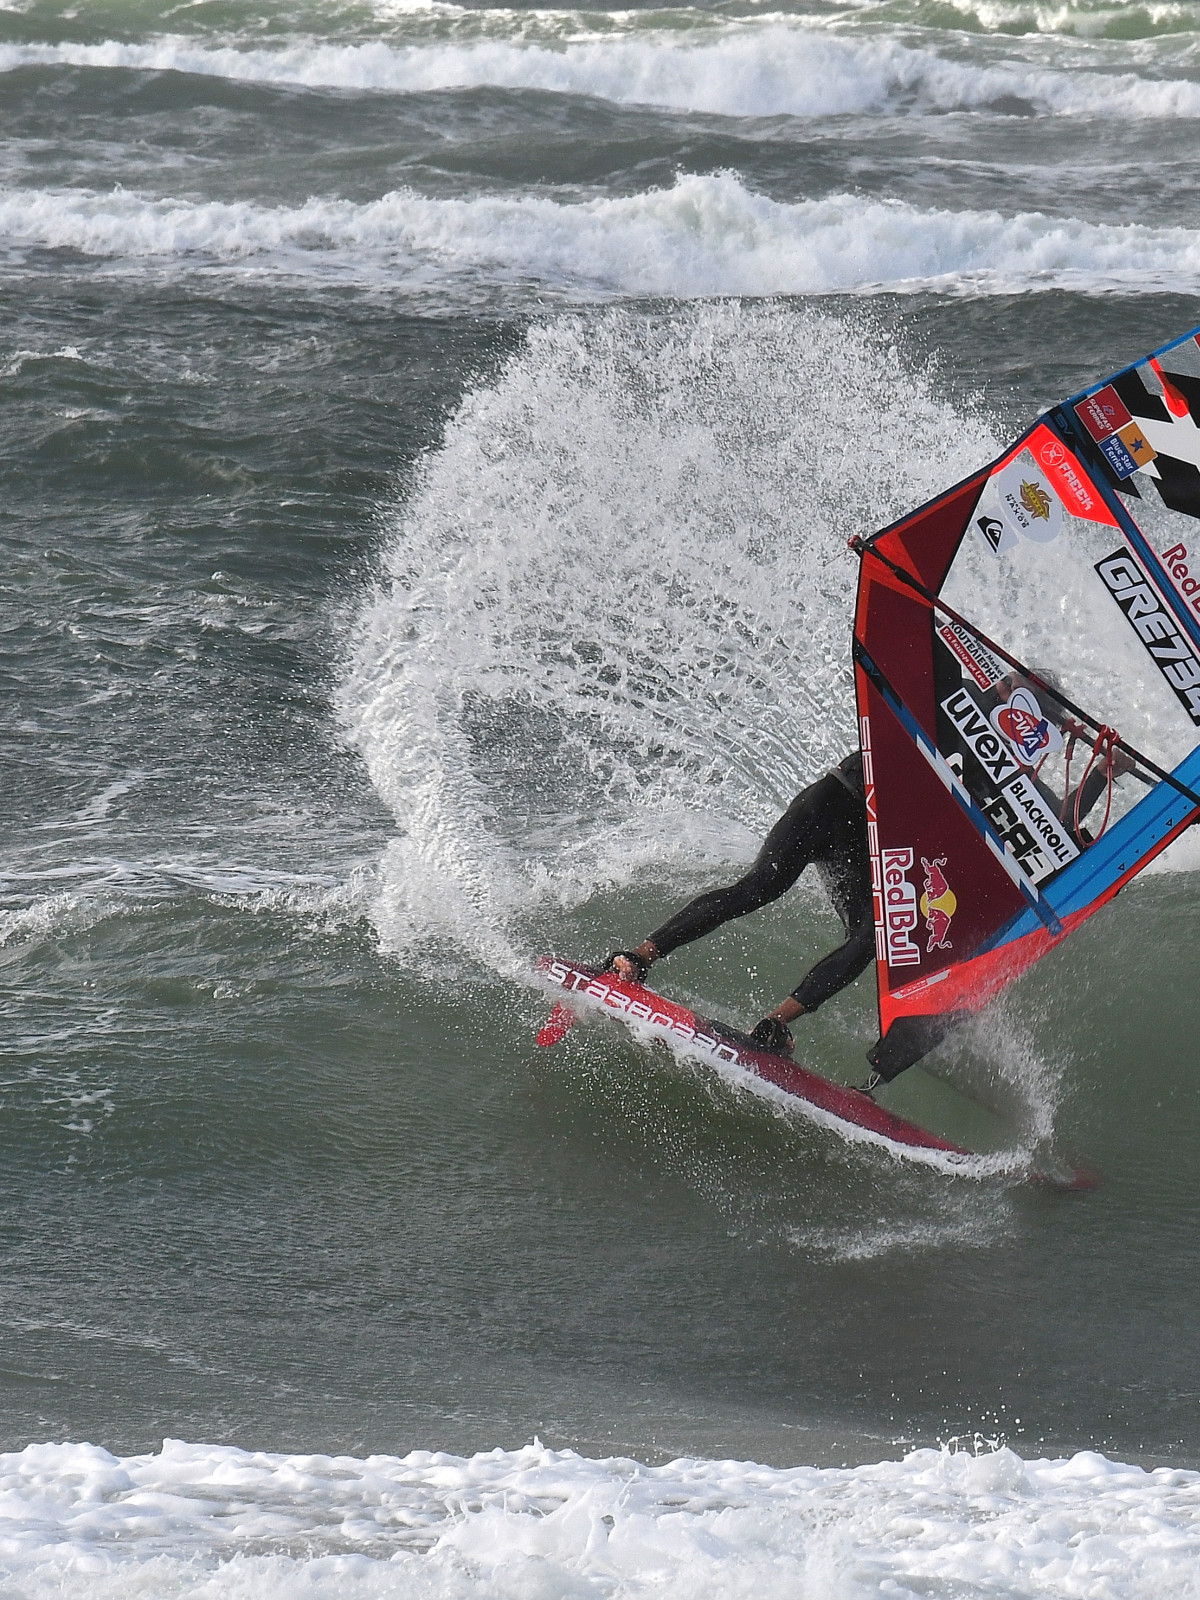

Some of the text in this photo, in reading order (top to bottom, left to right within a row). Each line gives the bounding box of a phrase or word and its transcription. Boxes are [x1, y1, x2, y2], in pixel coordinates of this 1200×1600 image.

[1086, 405, 1105, 430] FERRIES
[1089, 398, 1114, 432] SUPERFAST
[1105, 446, 1124, 473] Ferries
[1109, 437, 1134, 470] Blue Star
[1005, 494, 1028, 529] NAXOS
[973, 639, 1005, 677] Super Market
[946, 691, 1015, 780] uvex
[1007, 710, 1040, 749] PWA
[860, 716, 887, 961] SEVERNE
